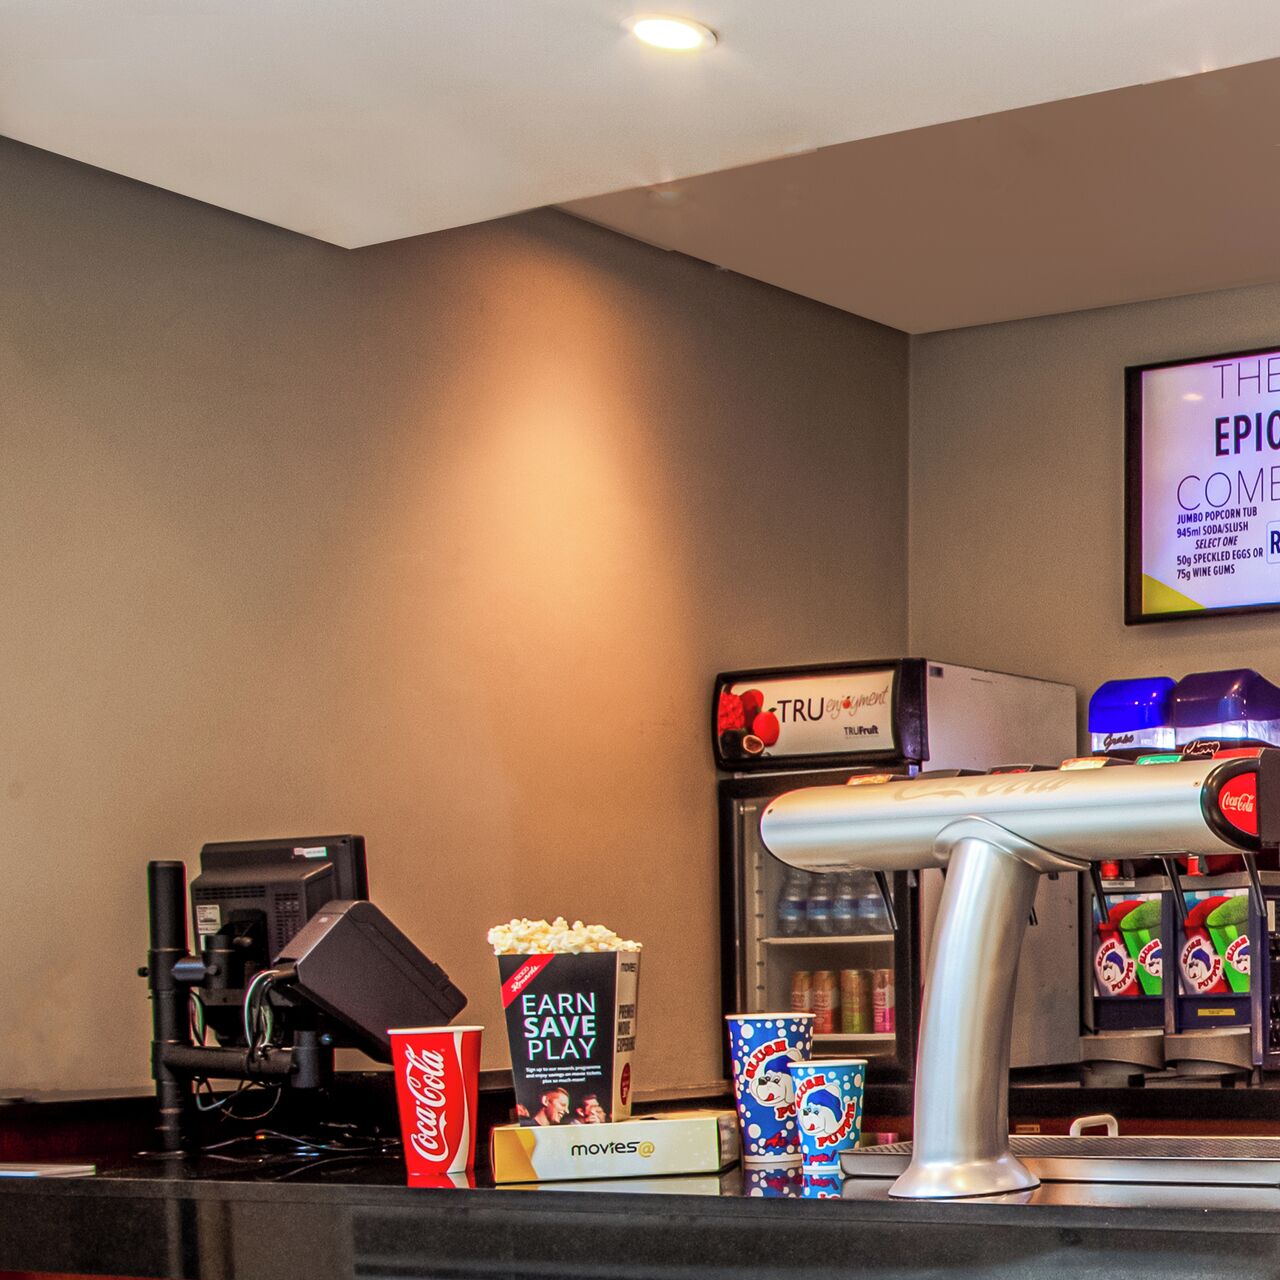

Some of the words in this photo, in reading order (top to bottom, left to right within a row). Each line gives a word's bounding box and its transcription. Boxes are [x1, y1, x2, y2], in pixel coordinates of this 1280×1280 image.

[1177, 511, 1203, 525] JUMBO
[1205, 508, 1241, 522] POPCORN
[1243, 506, 1258, 517] TUB
[1177, 526, 1201, 538] 945ml
[1203, 521, 1249, 535] SODA/SLUSH
[1195, 537, 1221, 550] SELECT
[1223, 535, 1238, 546] ONE
[1177, 555, 1192, 567] 50g
[1193, 550, 1231, 564] SPECKLED
[1232, 549, 1251, 560] EGGS
[1253, 547, 1264, 557] OR
[1177, 569, 1191, 581] 75g
[1192, 566, 1211, 578] WINE
[1213, 564, 1235, 576] GUMS
[777, 697, 825, 723] TRU
[522, 992, 595, 1016] EARN
[524, 1015, 596, 1038] SAVE
[528, 1038, 595, 1061] PLAY
[746, 1040, 787, 1079] SLUSH
[571, 1141, 655, 1158] movies@
